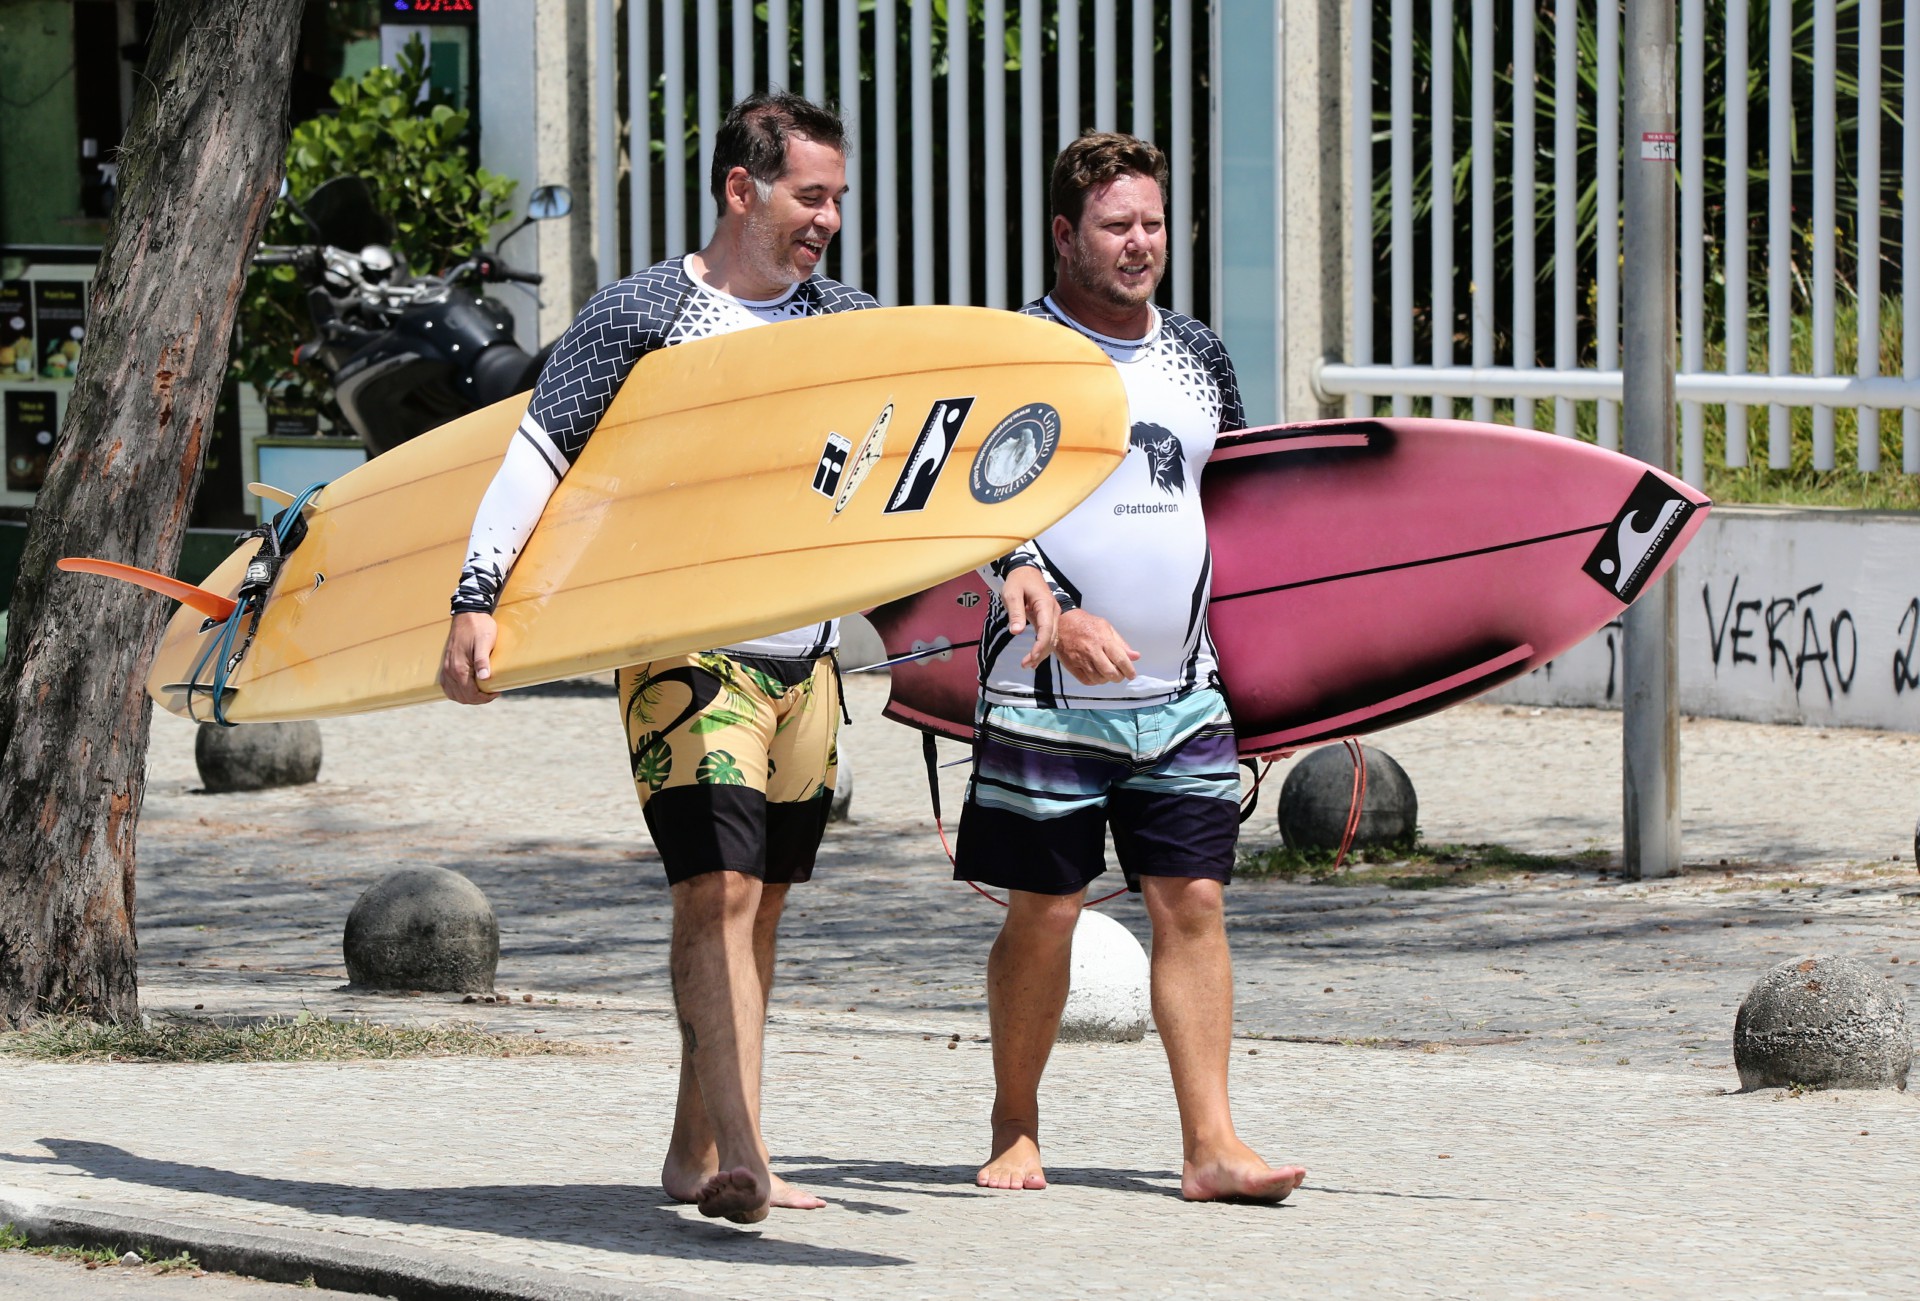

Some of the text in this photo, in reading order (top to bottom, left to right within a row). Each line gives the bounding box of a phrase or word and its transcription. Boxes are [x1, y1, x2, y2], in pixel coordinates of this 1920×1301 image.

[993, 410, 1057, 500] Grupo Harpia
[1113, 502, 1179, 516] @tattookron
